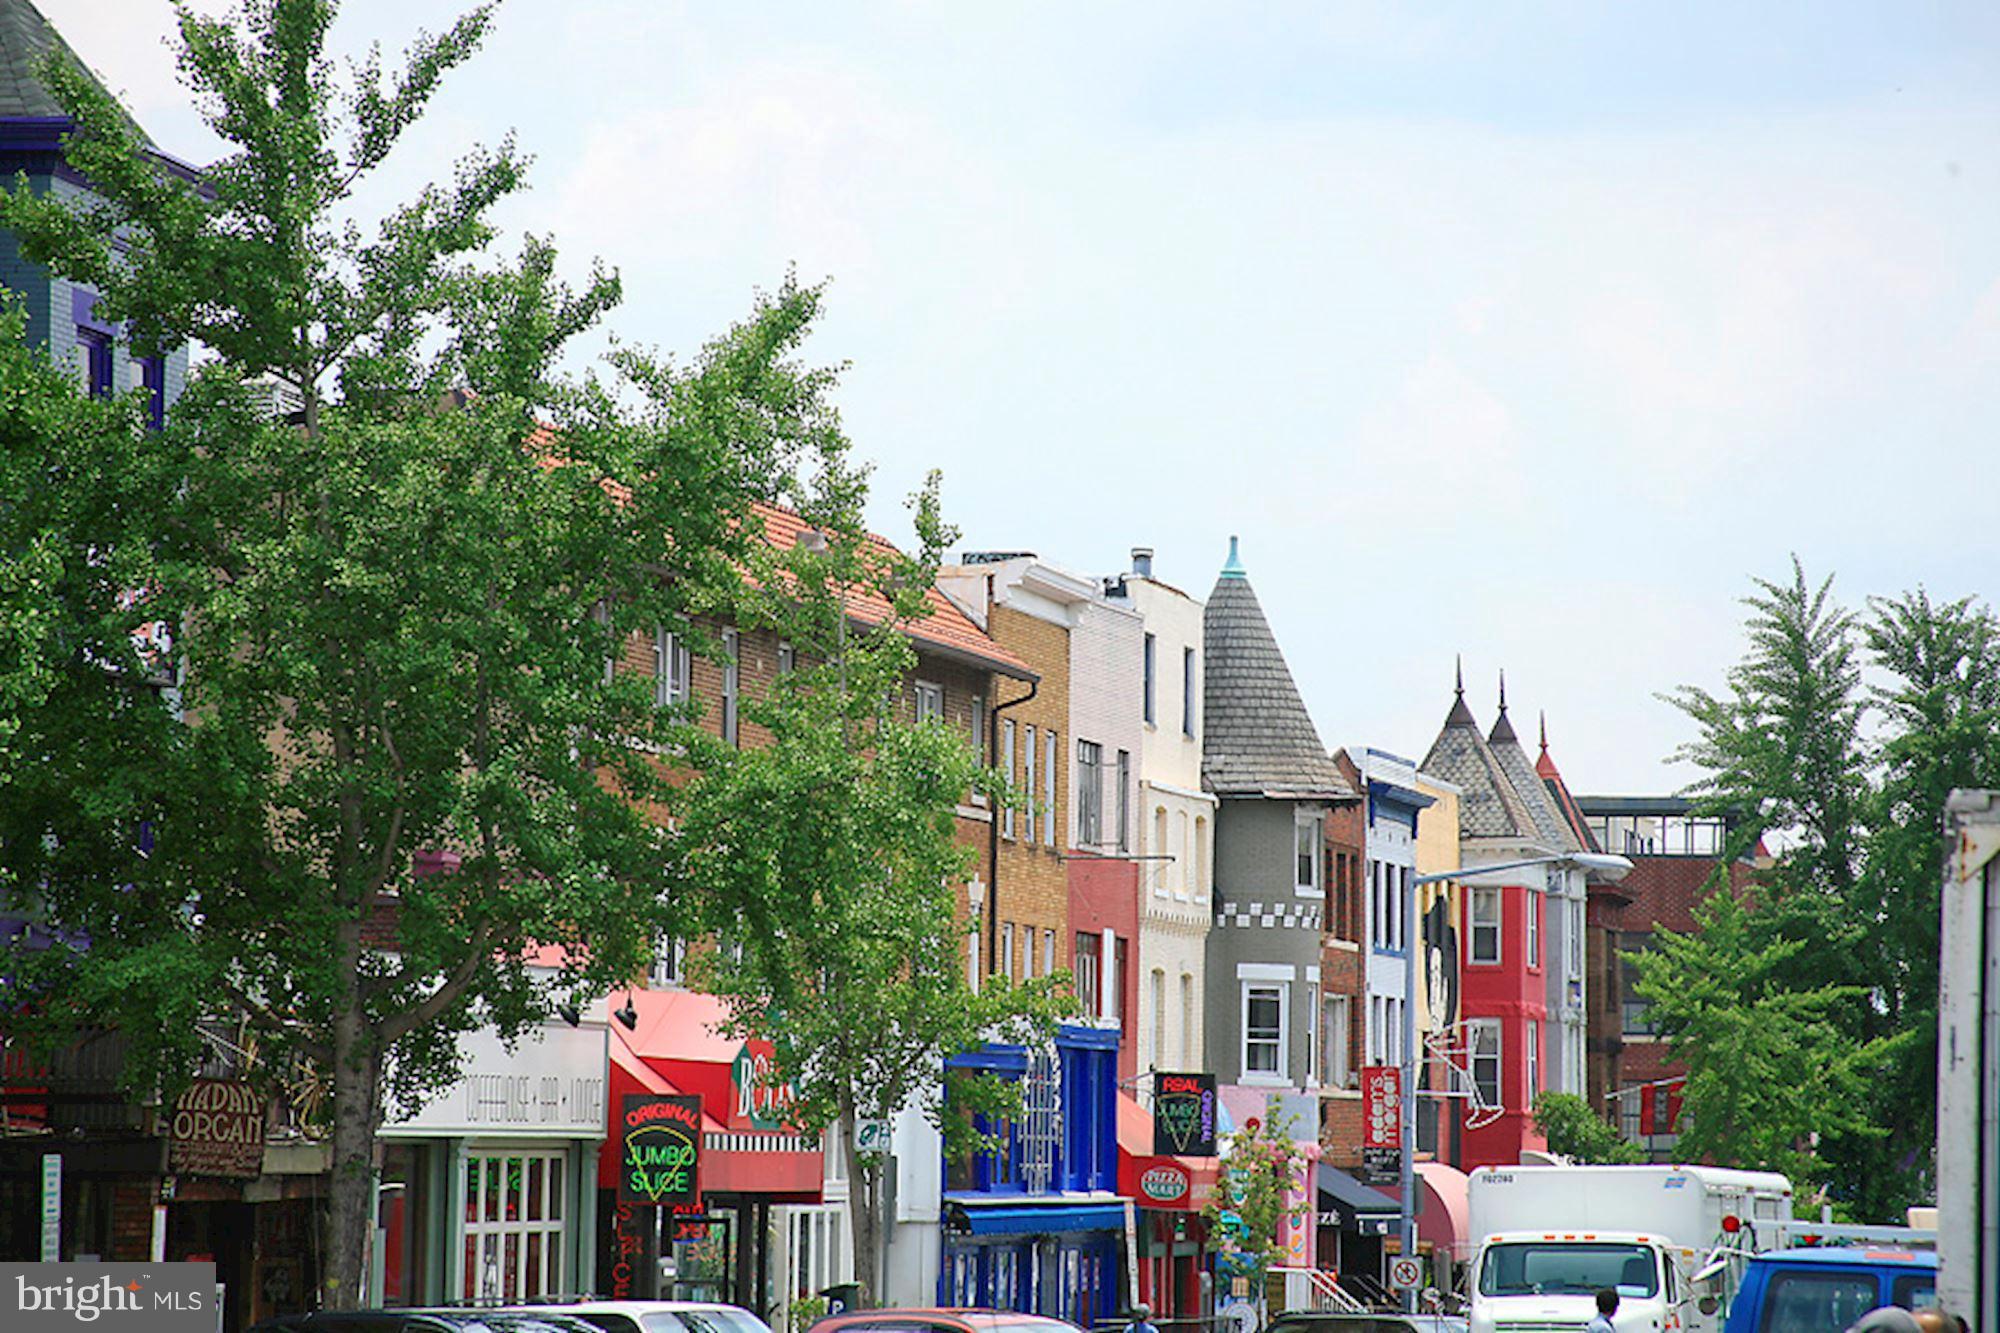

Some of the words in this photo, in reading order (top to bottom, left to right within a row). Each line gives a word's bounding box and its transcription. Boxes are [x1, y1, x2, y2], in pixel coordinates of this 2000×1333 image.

[625, 1102, 698, 1130] ORIGINAL
[1367, 1076, 1384, 1143] adams
[1381, 1068, 1400, 1145] morgan
[173, 1111, 264, 1144] ORGAN
[625, 1145, 697, 1166] JUMBO
[629, 1170, 689, 1193] SLICE
[1143, 1169, 1185, 1185] PIZZA
